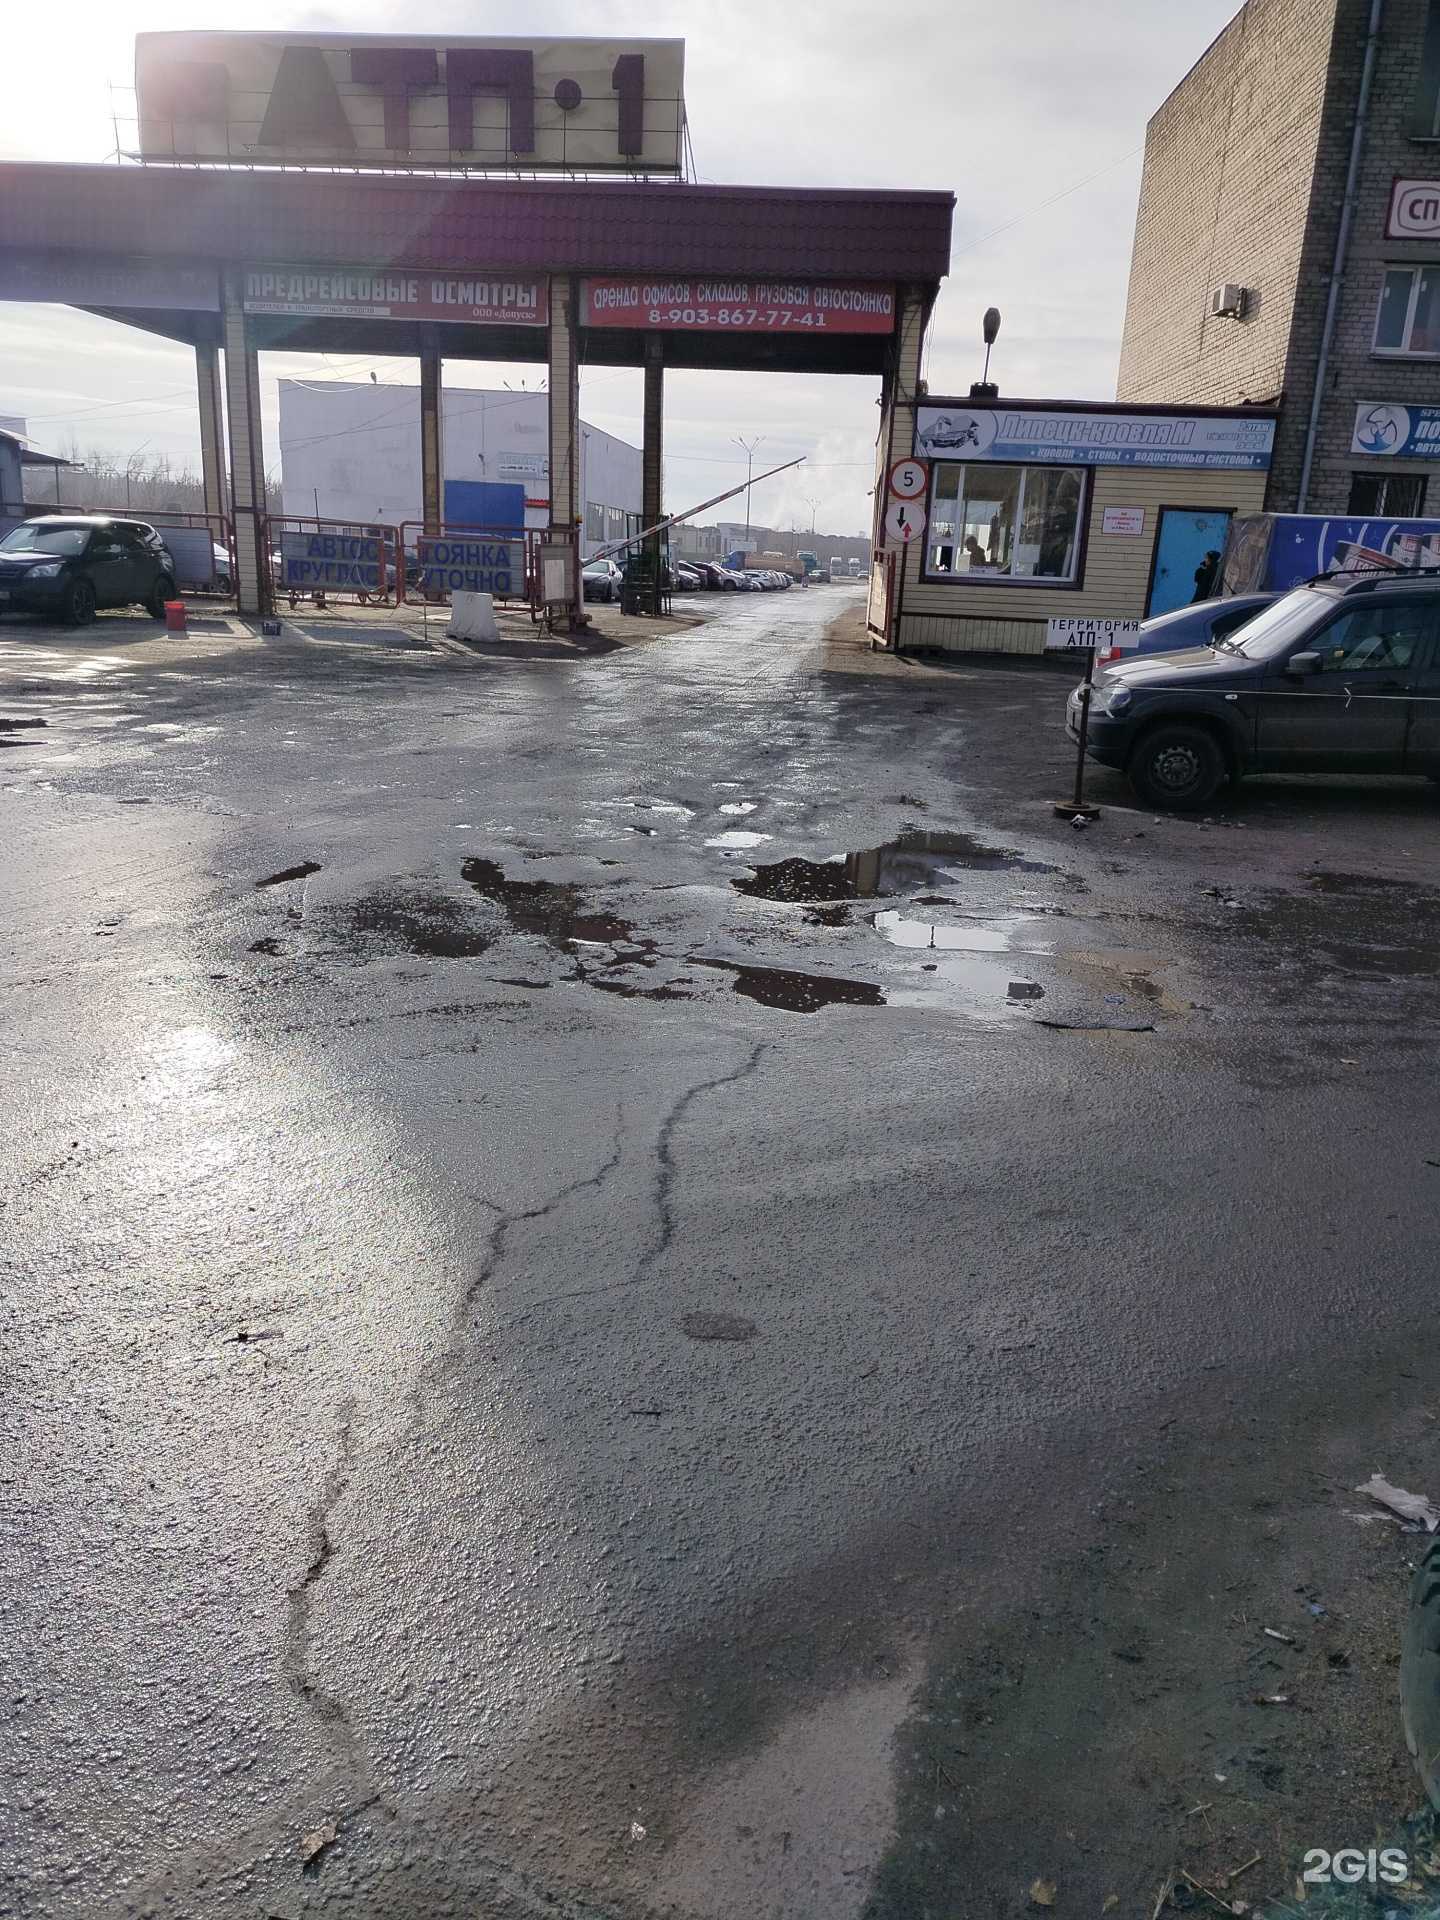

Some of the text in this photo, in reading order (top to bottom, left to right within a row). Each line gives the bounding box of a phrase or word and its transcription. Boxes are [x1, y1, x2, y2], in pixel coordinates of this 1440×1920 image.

[248, 272, 537, 308] ПРЕДРЕЙСОВЫЕ ОСМОТРЫ
[472, 307, 493, 317] ООО
[649, 309, 827, 327] 8-903-867-77-41
[904, 471, 914, 487] 5
[1052, 619, 1139, 632] ТЕРРИТОРИЯ
